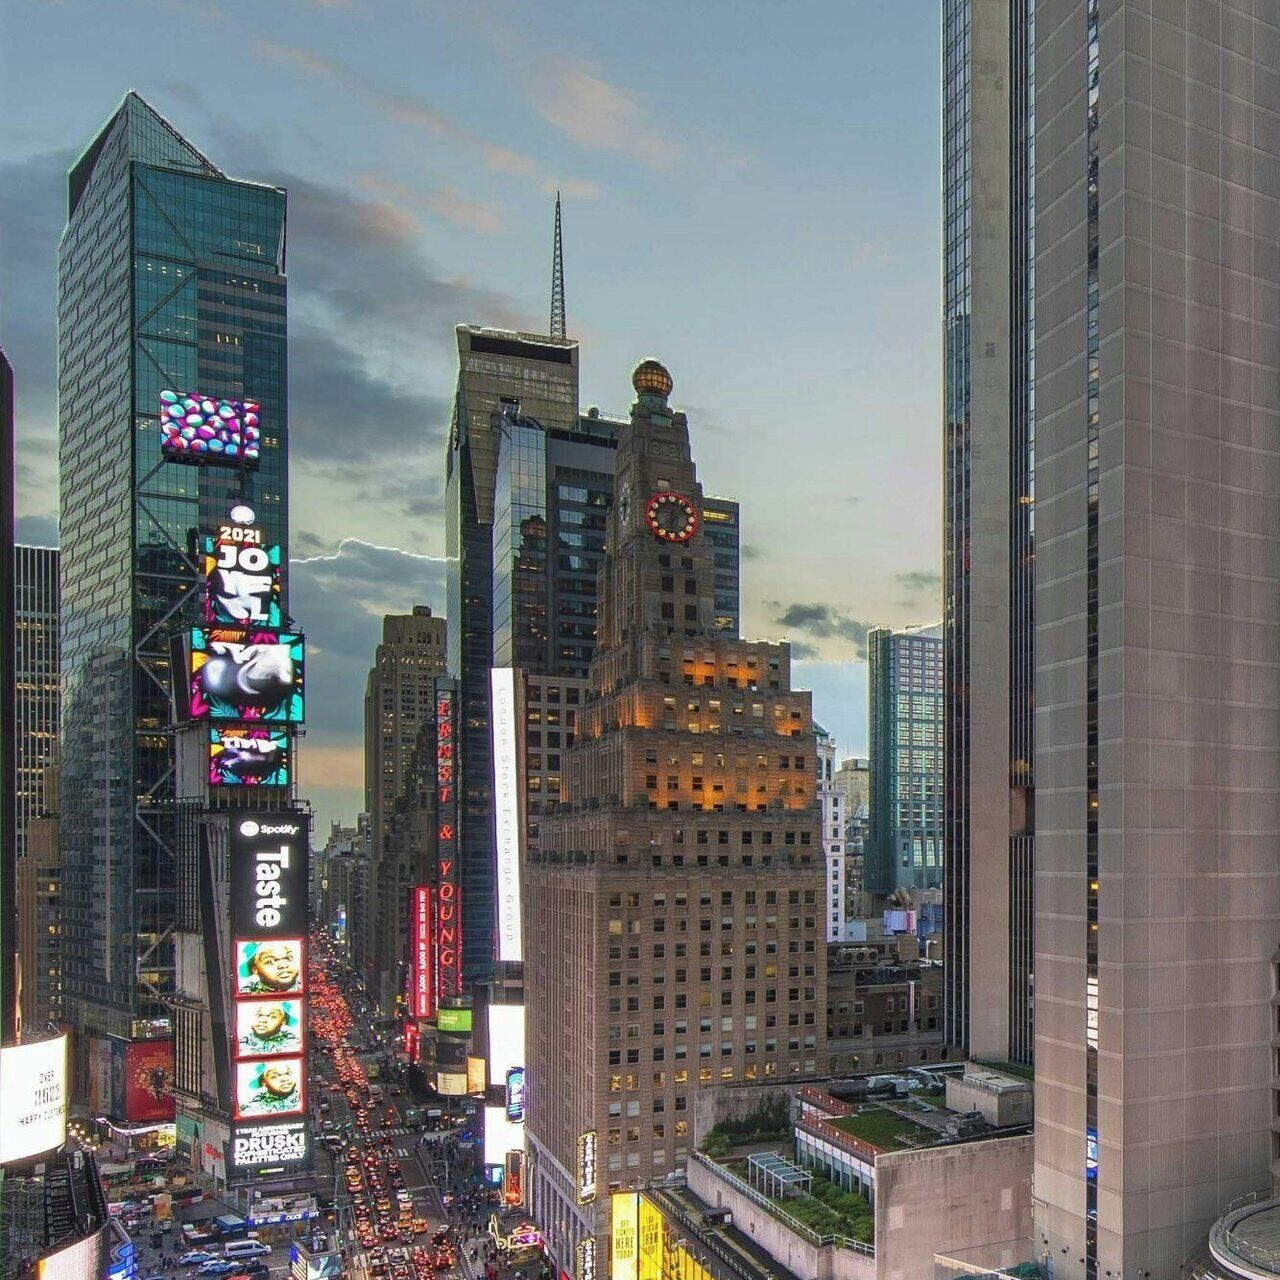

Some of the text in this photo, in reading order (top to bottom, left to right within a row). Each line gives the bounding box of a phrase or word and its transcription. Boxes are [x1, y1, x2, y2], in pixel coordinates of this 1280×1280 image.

[220, 526, 260, 543] 2021
[438, 701, 452, 802] ERNST
[260, 824, 299, 835] Spotify
[256, 846, 289, 927] Taste
[440, 862, 454, 965] YOUNG
[235, 1133, 305, 1152] DRUSKI
[615, 1236, 634, 1249] HERE
[615, 1248, 634, 1260] TODAY
